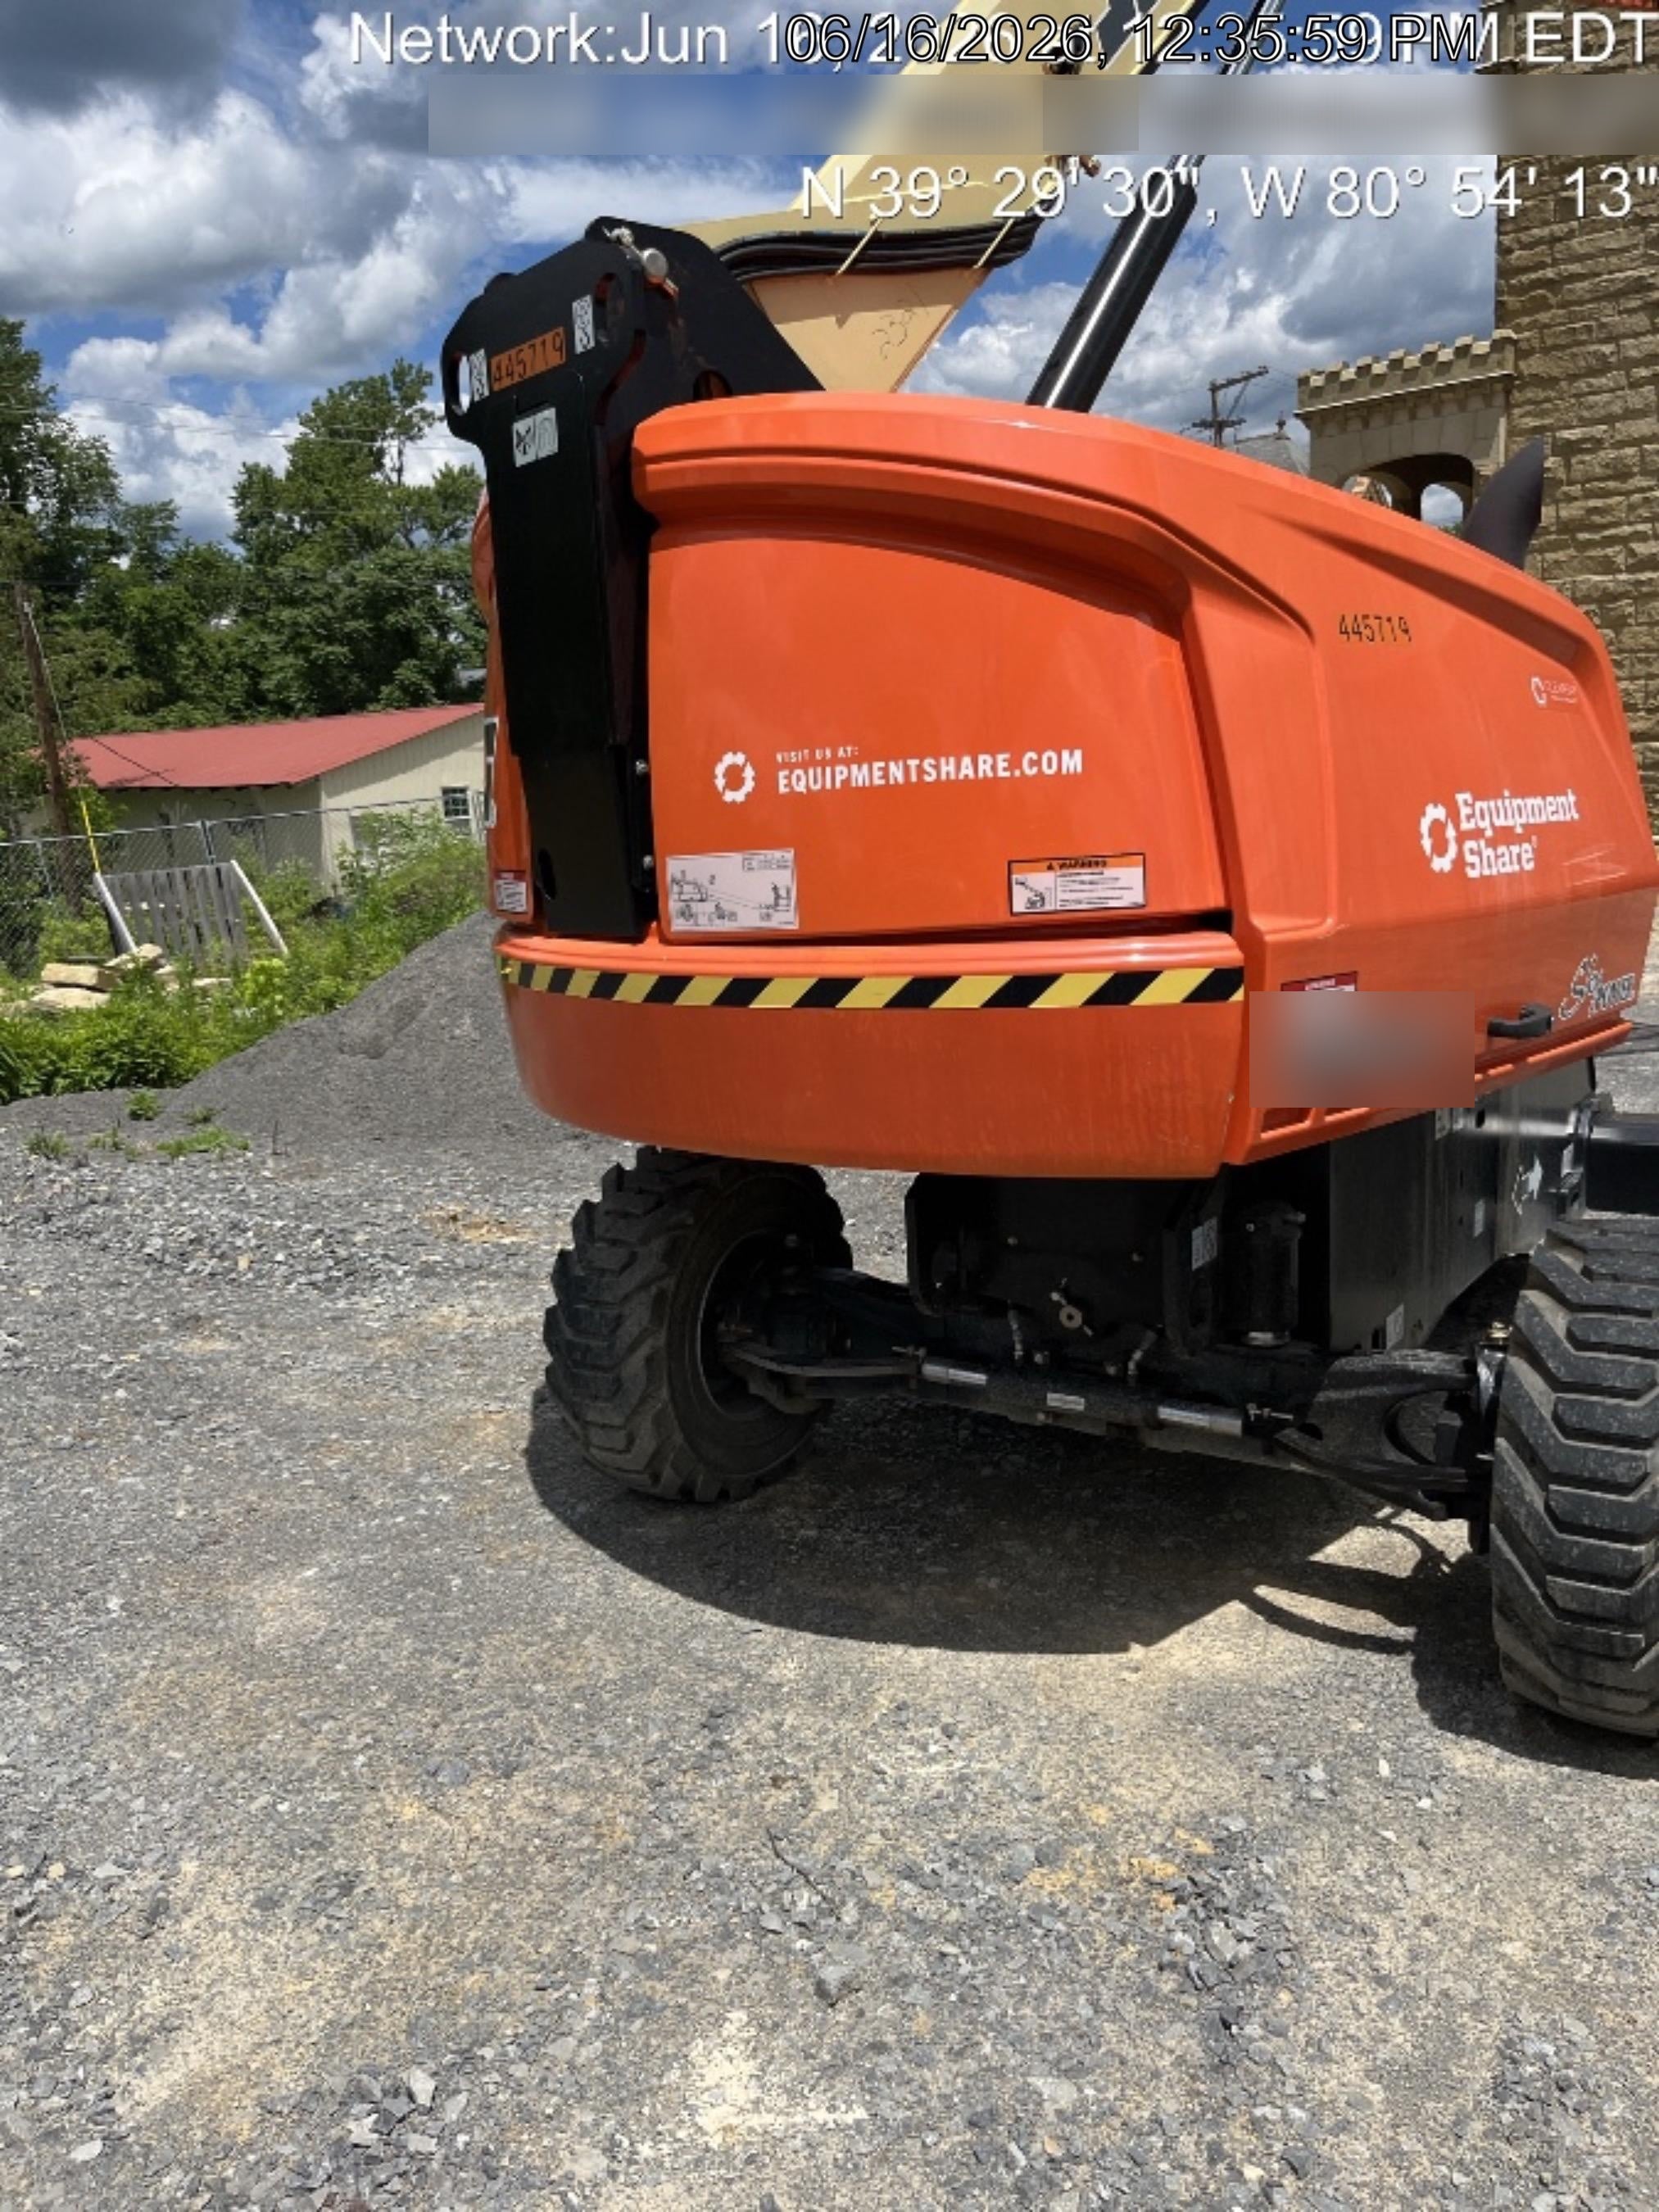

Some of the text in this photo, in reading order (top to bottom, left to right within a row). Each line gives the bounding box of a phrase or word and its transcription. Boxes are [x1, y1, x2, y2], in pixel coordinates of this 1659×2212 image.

[493, 332, 564, 383] 445719
[1339, 614, 1412, 642] 445719
[777, 748, 1083, 796] EQUIPMENTSHARE.COM
[815, 747, 832, 760] US
[1455, 788, 1579, 837] Equipment
